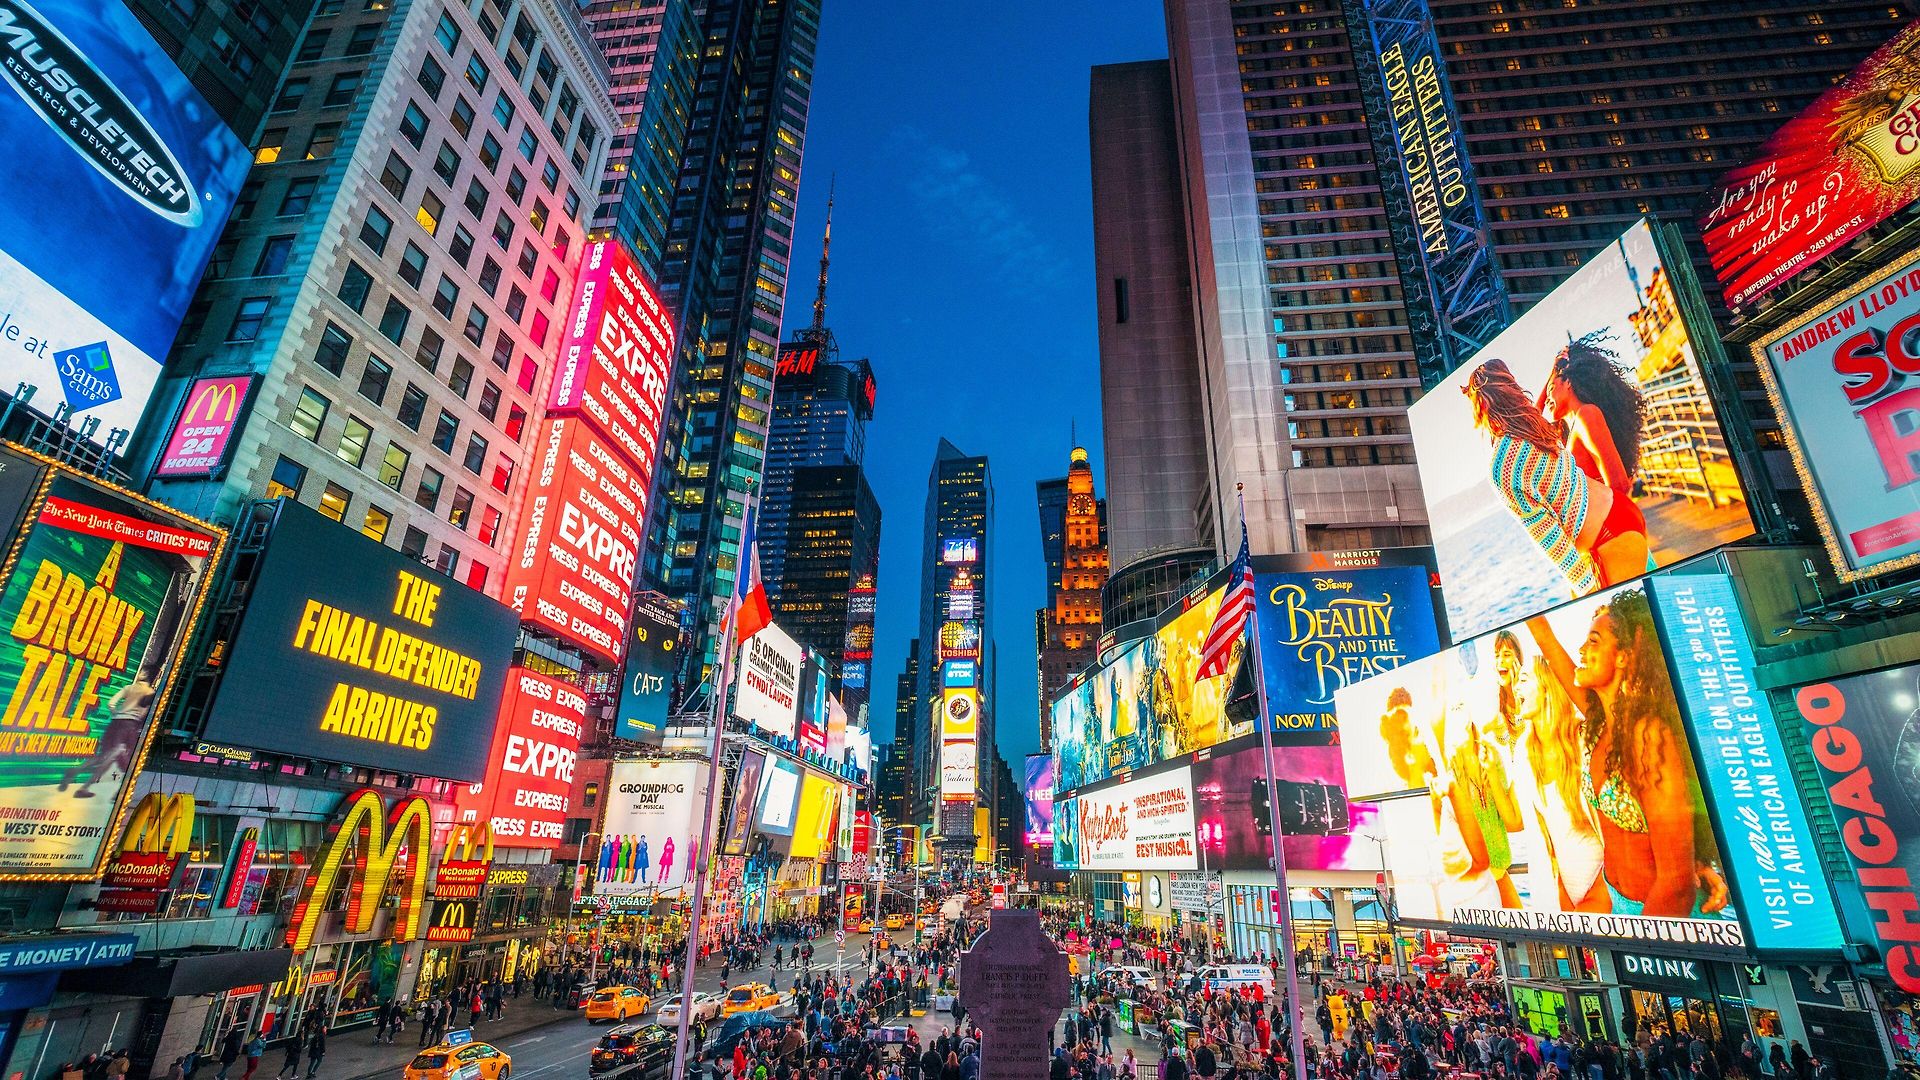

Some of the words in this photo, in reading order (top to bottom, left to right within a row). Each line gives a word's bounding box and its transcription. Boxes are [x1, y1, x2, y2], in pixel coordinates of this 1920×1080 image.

[1381, 42, 1415, 122] EAGLE
[6, 56, 67, 117] RESEARCH
[69, 117, 78, 129] &
[80, 127, 152, 196] DEVELOPMENT
[1411, 55, 1467, 207] OUTFITTERS
[1397, 116, 1449, 254] AMERICAN
[1704, 188, 1745, 230] Are
[1744, 162, 1777, 211] you
[1728, 178, 1776, 238] ready
[1782, 180, 1798, 200] to
[1751, 199, 1800, 255] wake
[1805, 172, 1843, 235] up?
[1743, 274, 1775, 297] IMPERIAL
[1774, 251, 1807, 279] THEATRE
[1810, 240, 1826, 254] 249
[1851, 216, 1865, 228] ST.
[573, 281, 596, 338] EXPRESS
[626, 265, 659, 316] EXPRESS
[24, 336, 48, 359] at
[618, 305, 651, 353] EXPRESS
[636, 303, 667, 350] EXPRESS
[60, 354, 113, 400] Sam's
[557, 345, 581, 406] EXPRESS
[775, 350, 817, 376] H&M
[601, 381, 638, 427] EXPRESS
[621, 377, 653, 420] EXPRESS
[180, 438, 215, 457] 24
[183, 426, 225, 438] OPEN
[612, 421, 646, 462] EXPRESS
[164, 456, 218, 469] HOURS
[540, 420, 564, 487] EXPRESS
[589, 440, 628, 484] EXPRESS
[579, 487, 619, 528] EXPRESS
[600, 476, 635, 516] EXPRESS
[43, 501, 64, 517] The
[64, 508, 87, 524] New
[87, 514, 114, 530] York
[114, 520, 145, 539] Times
[145, 529, 188, 548] CRITICS'
[189, 537, 211, 552] PICK
[521, 496, 548, 569] EXPRESS
[95, 540, 124, 591] A
[1333, 550, 1381, 559] MARRIOTT
[1334, 558, 1377, 567] MARQUIS
[392, 569, 441, 628] THE
[560, 580, 602, 615] EXPRESS
[581, 564, 620, 599] EXPRESS
[1312, 577, 1353, 593] Disney
[10, 558, 145, 671] BRONX
[1269, 584, 1393, 646] BEAUTY
[1674, 587, 1702, 634] LEVEL
[293, 598, 378, 670] FINAL
[373, 626, 482, 701] DEFENDER
[571, 617, 611, 648] EXPRESS
[941, 649, 978, 657] TOSHIBA
[1338, 640, 1366, 654] AND
[1369, 639, 1398, 653] THE
[751, 634, 761, 654] 16
[762, 643, 795, 680] ORIGINAL
[1705, 606, 1753, 708] OUTFITTERS
[1, 644, 111, 733] TALE
[633, 672, 664, 696] CATS
[747, 670, 768, 696] CYNDI
[769, 685, 792, 711] LAUPER
[1702, 672, 1727, 701] THE
[319, 682, 437, 750] ARRIVES
[531, 709, 576, 735] EXPRESS
[1275, 714, 1316, 729] NOW
[1713, 706, 1733, 730] ON
[25, 734, 50, 753] NEW
[47, 735, 66, 754] HIT
[62, 737, 98, 755] MUSICAL
[1743, 712, 1769, 766] EAGLE
[1718, 735, 1754, 798] INSIDE
[515, 789, 562, 811] EXPRESS
[619, 783, 685, 794] GROUNDHOG
[640, 794, 660, 804] DAY
[4, 822, 38, 835] WEST
[38, 824, 65, 836] SIDE
[65, 825, 102, 838] STORY.
[49, 810, 62, 821] OF
[1080, 799, 1104, 865] Kinky
[1103, 802, 1128, 840] Boots
[1137, 809, 1147, 820] AND
[1757, 773, 1806, 873] AMERICAN
[1135, 843, 1154, 858] BEST
[1155, 838, 1193, 857] MUSICAL
[1734, 806, 1777, 871] aerie
[1796, 683, 1920, 995] CHICAGO
[107, 861, 170, 877] McDonald's
[439, 867, 485, 876] McDonald's
[488, 870, 528, 884] EXPRESS
[1760, 876, 1793, 931] VISIT
[1787, 879, 1815, 905] OF
[1452, 907, 1531, 930] AMERICAN
[1535, 912, 1594, 935] EAGLE
[1597, 914, 1743, 948] OUTFITTERS
[14, 946, 88, 966] MONEY
[94, 943, 133, 959] ATM
[1623, 954, 1698, 981] DRINK
